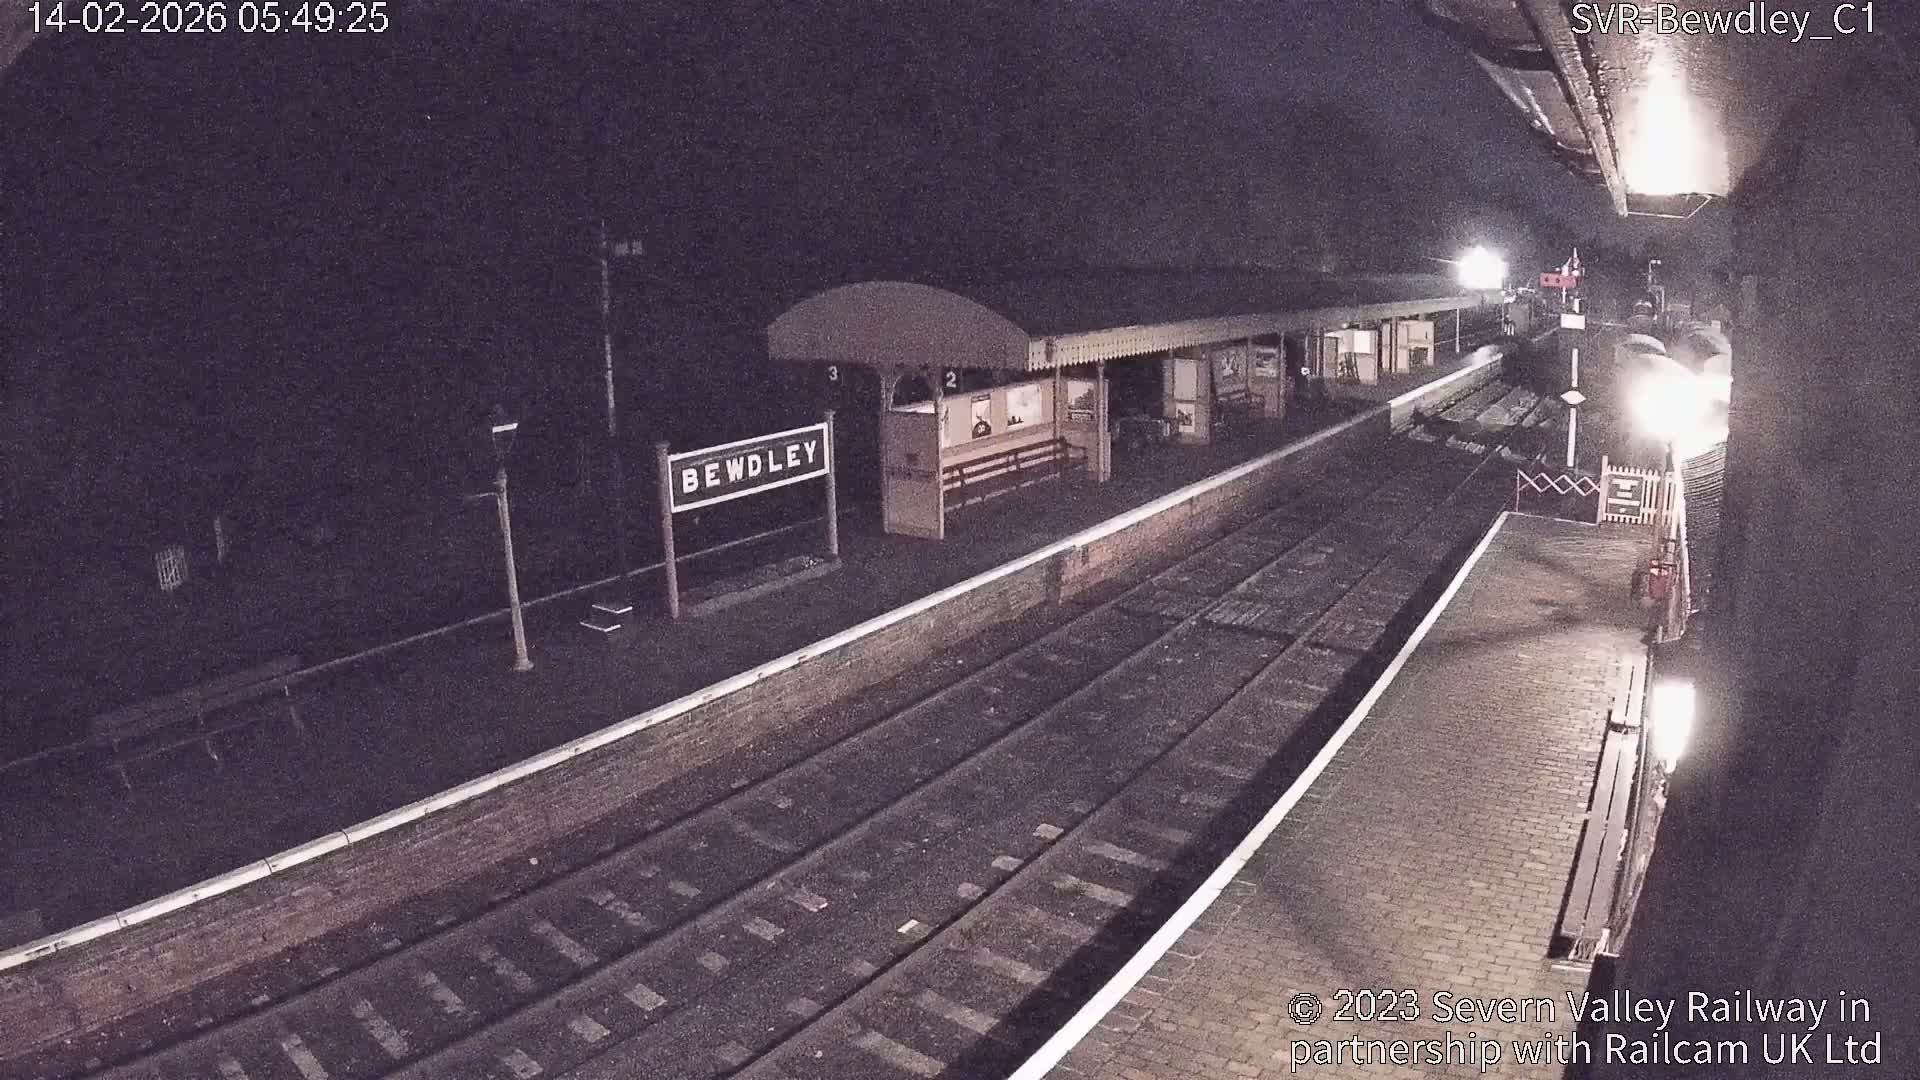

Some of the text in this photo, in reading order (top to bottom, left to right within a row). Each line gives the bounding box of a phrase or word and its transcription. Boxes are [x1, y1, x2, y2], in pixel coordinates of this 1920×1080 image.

[828, 366, 838, 381] 3
[946, 371, 957, 389] 2
[682, 440, 816, 493] BEWDLEY
